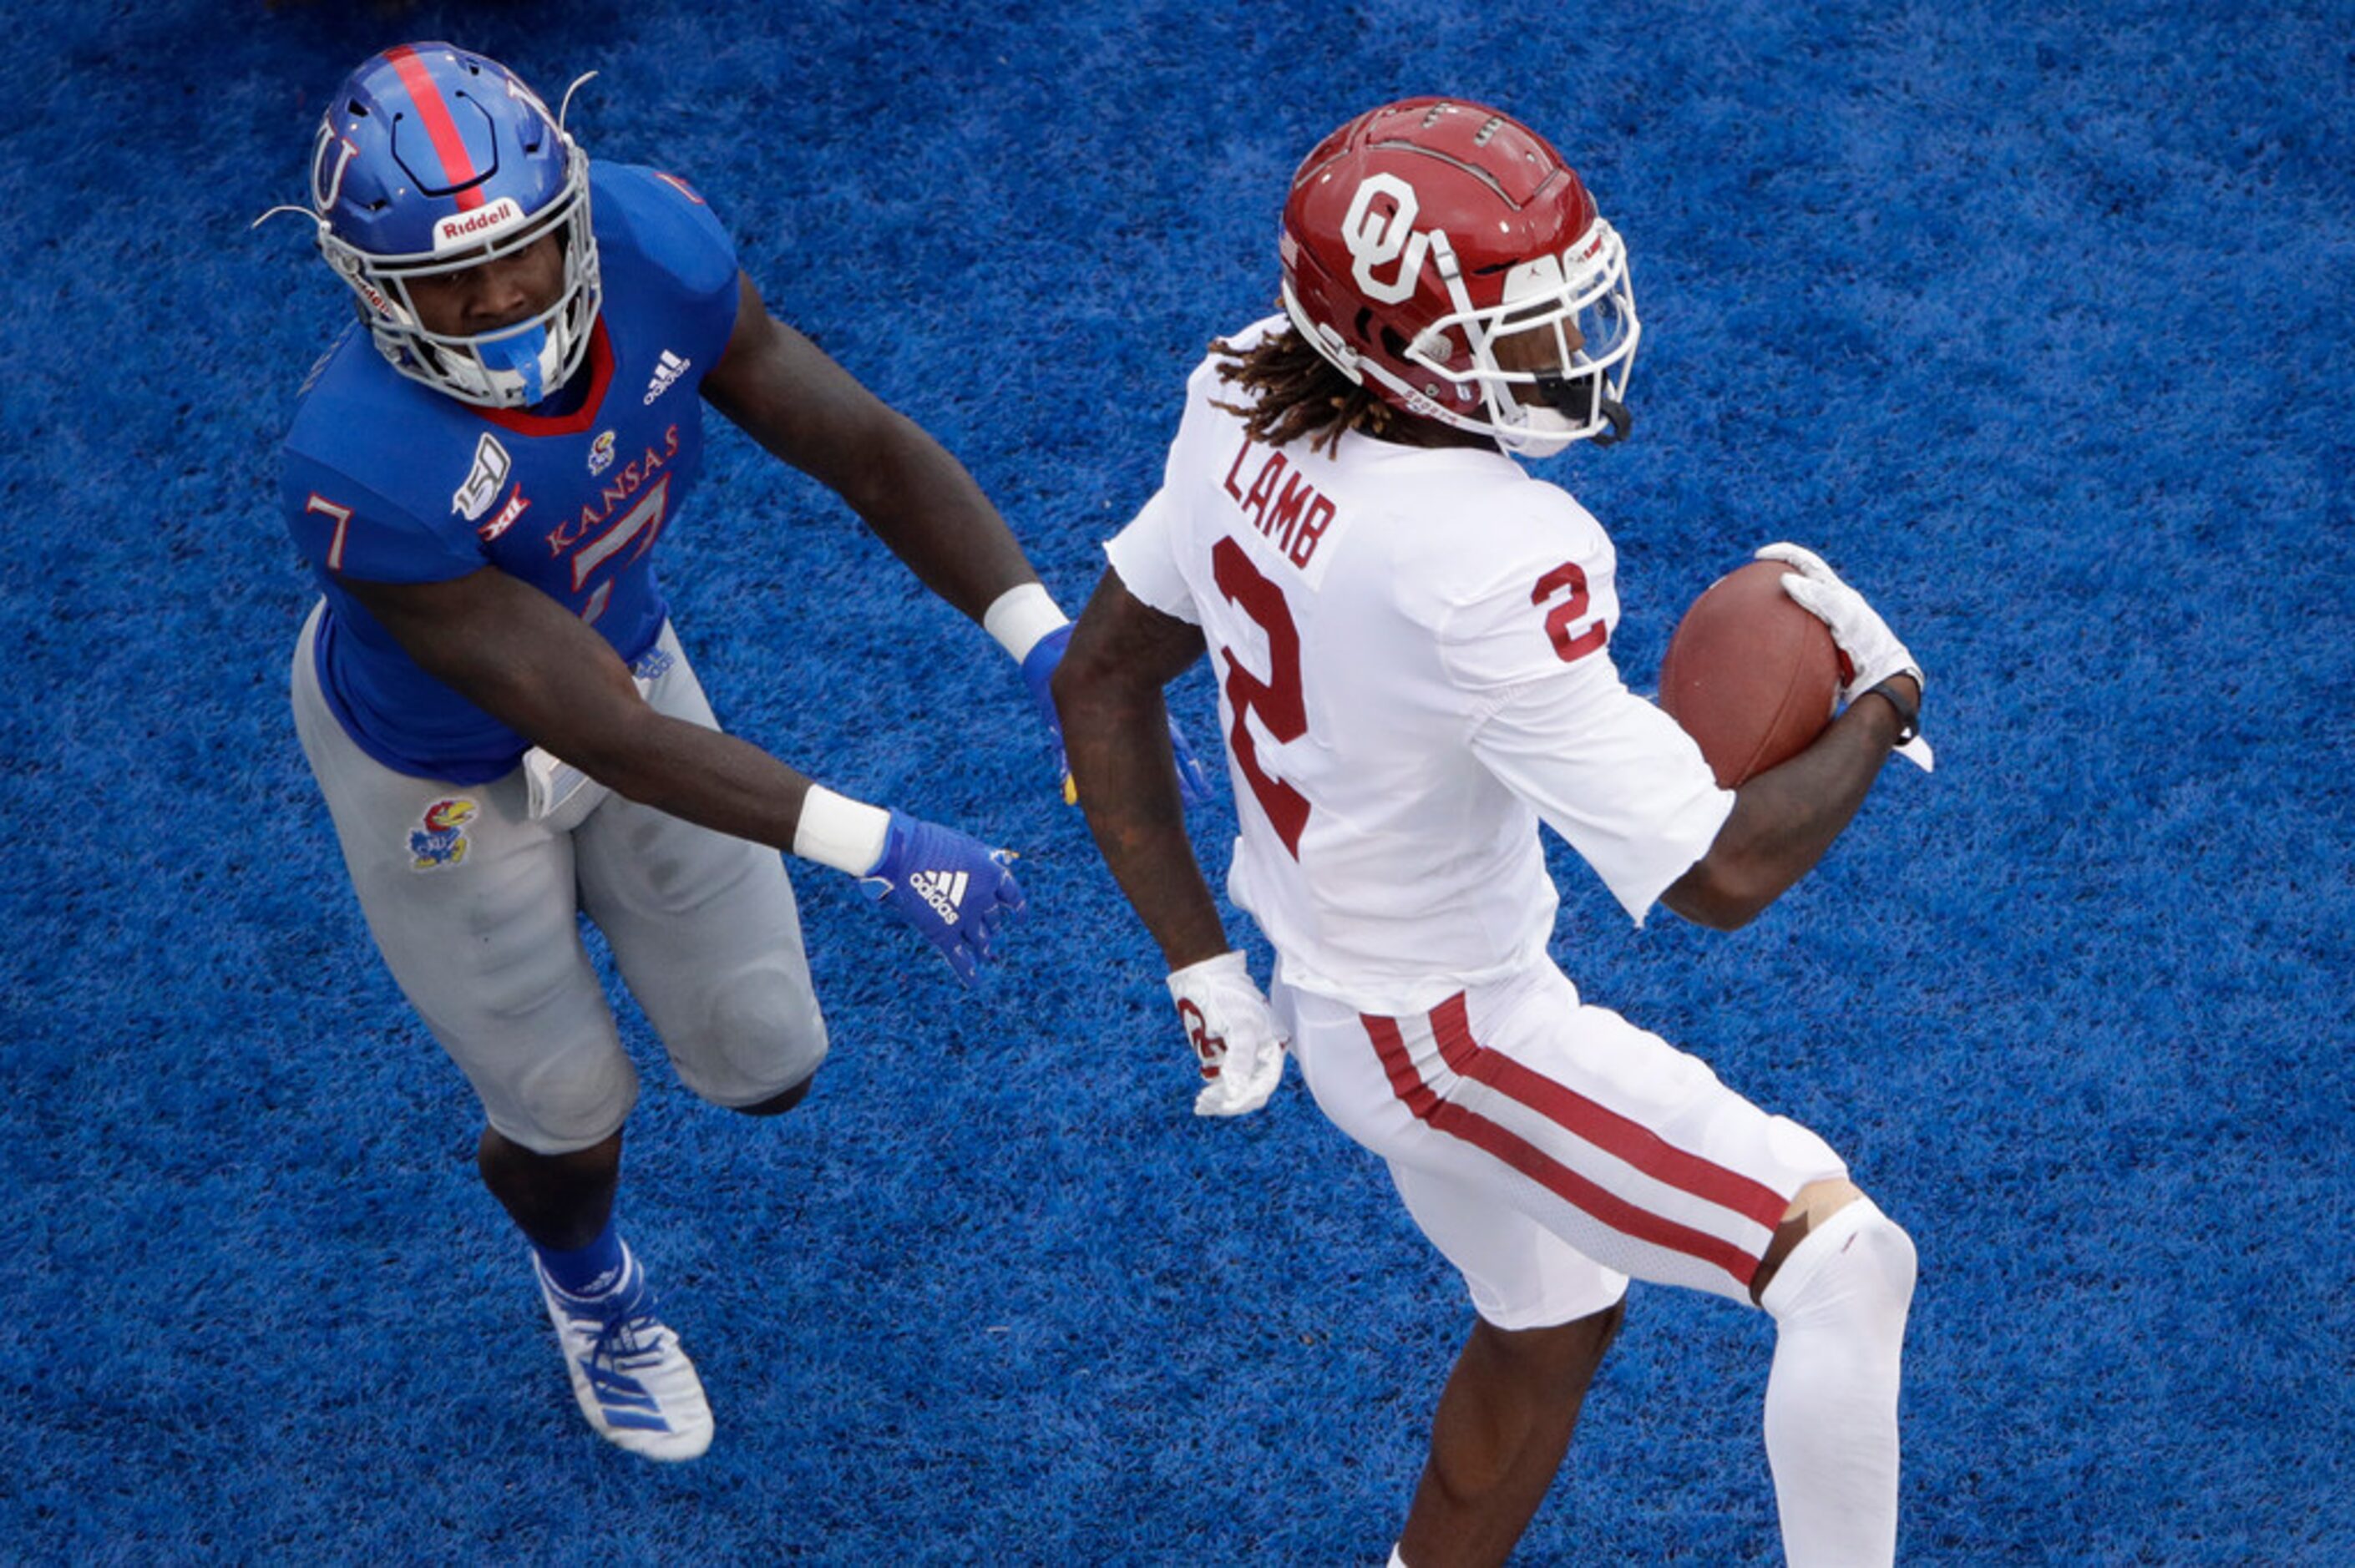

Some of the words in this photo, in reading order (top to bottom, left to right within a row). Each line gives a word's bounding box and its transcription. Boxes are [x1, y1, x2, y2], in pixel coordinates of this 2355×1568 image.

[443, 202, 511, 240] Riddell
[1340, 172, 1431, 306] OU
[643, 358, 691, 406] adidas
[454, 434, 509, 515] 150
[545, 424, 679, 559] KANSAS
[1223, 438, 1337, 571] LAMB
[306, 491, 355, 571] 7
[1531, 561, 1607, 662] 2
[1212, 534, 1311, 864] 2
[909, 872, 960, 926] adidas
